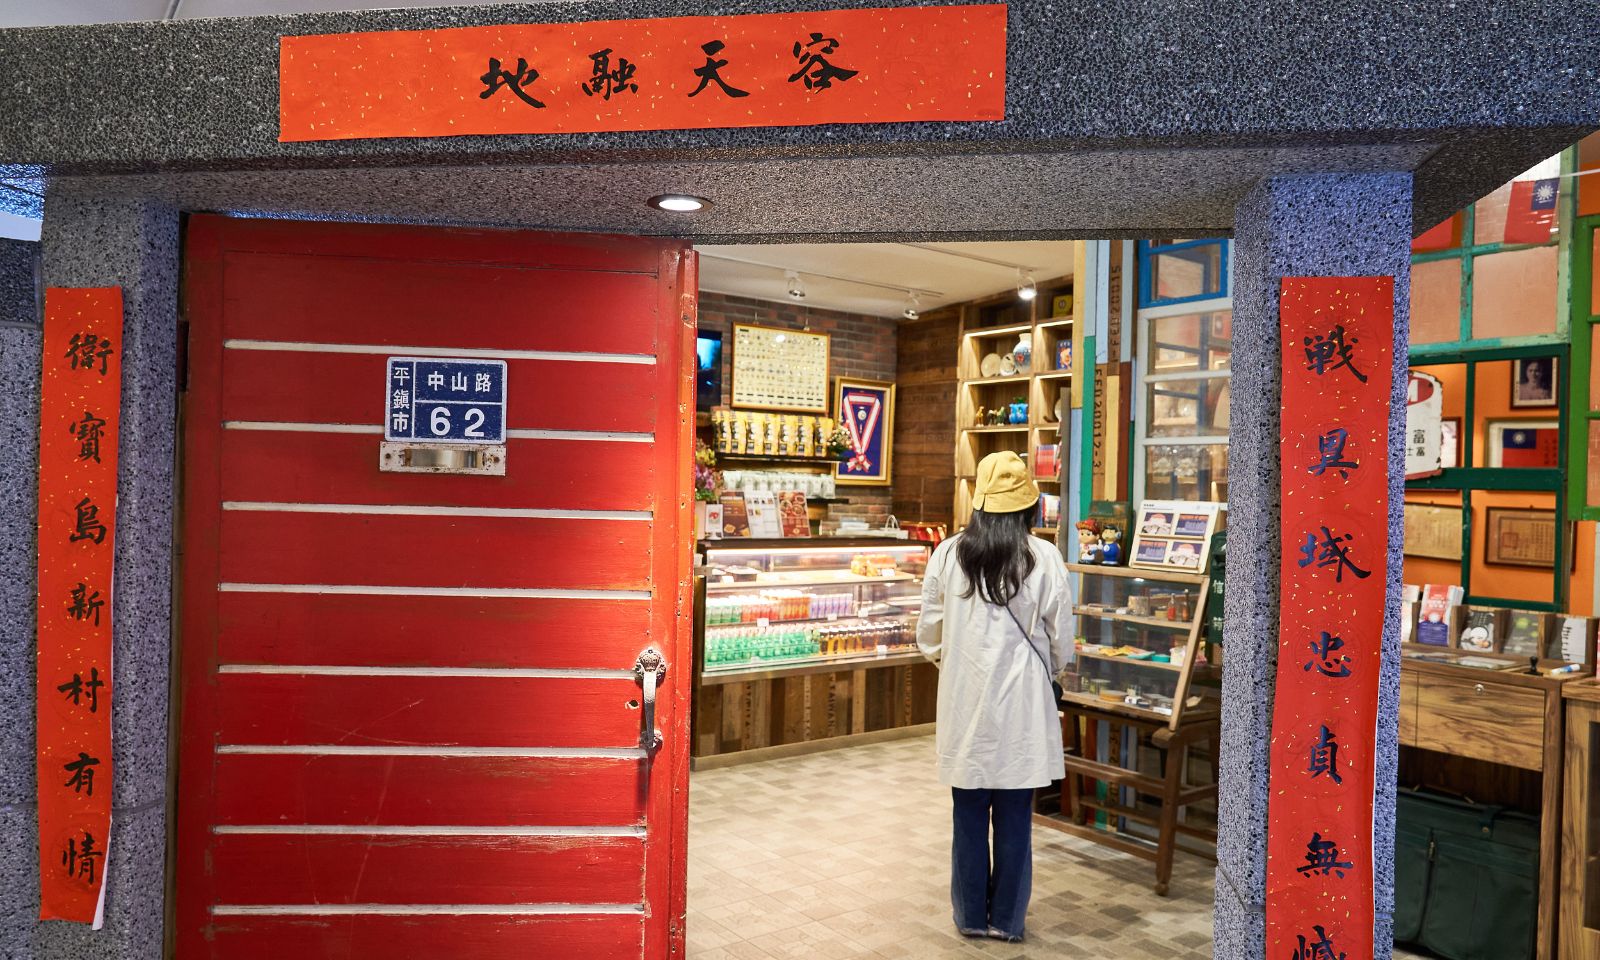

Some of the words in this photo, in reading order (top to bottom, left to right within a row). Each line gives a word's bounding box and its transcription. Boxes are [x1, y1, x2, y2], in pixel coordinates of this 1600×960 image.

[427, 370, 492, 393] 中山路
[430, 406, 485, 437] 62
[57, 334, 113, 886] 衛寶島新村有情
